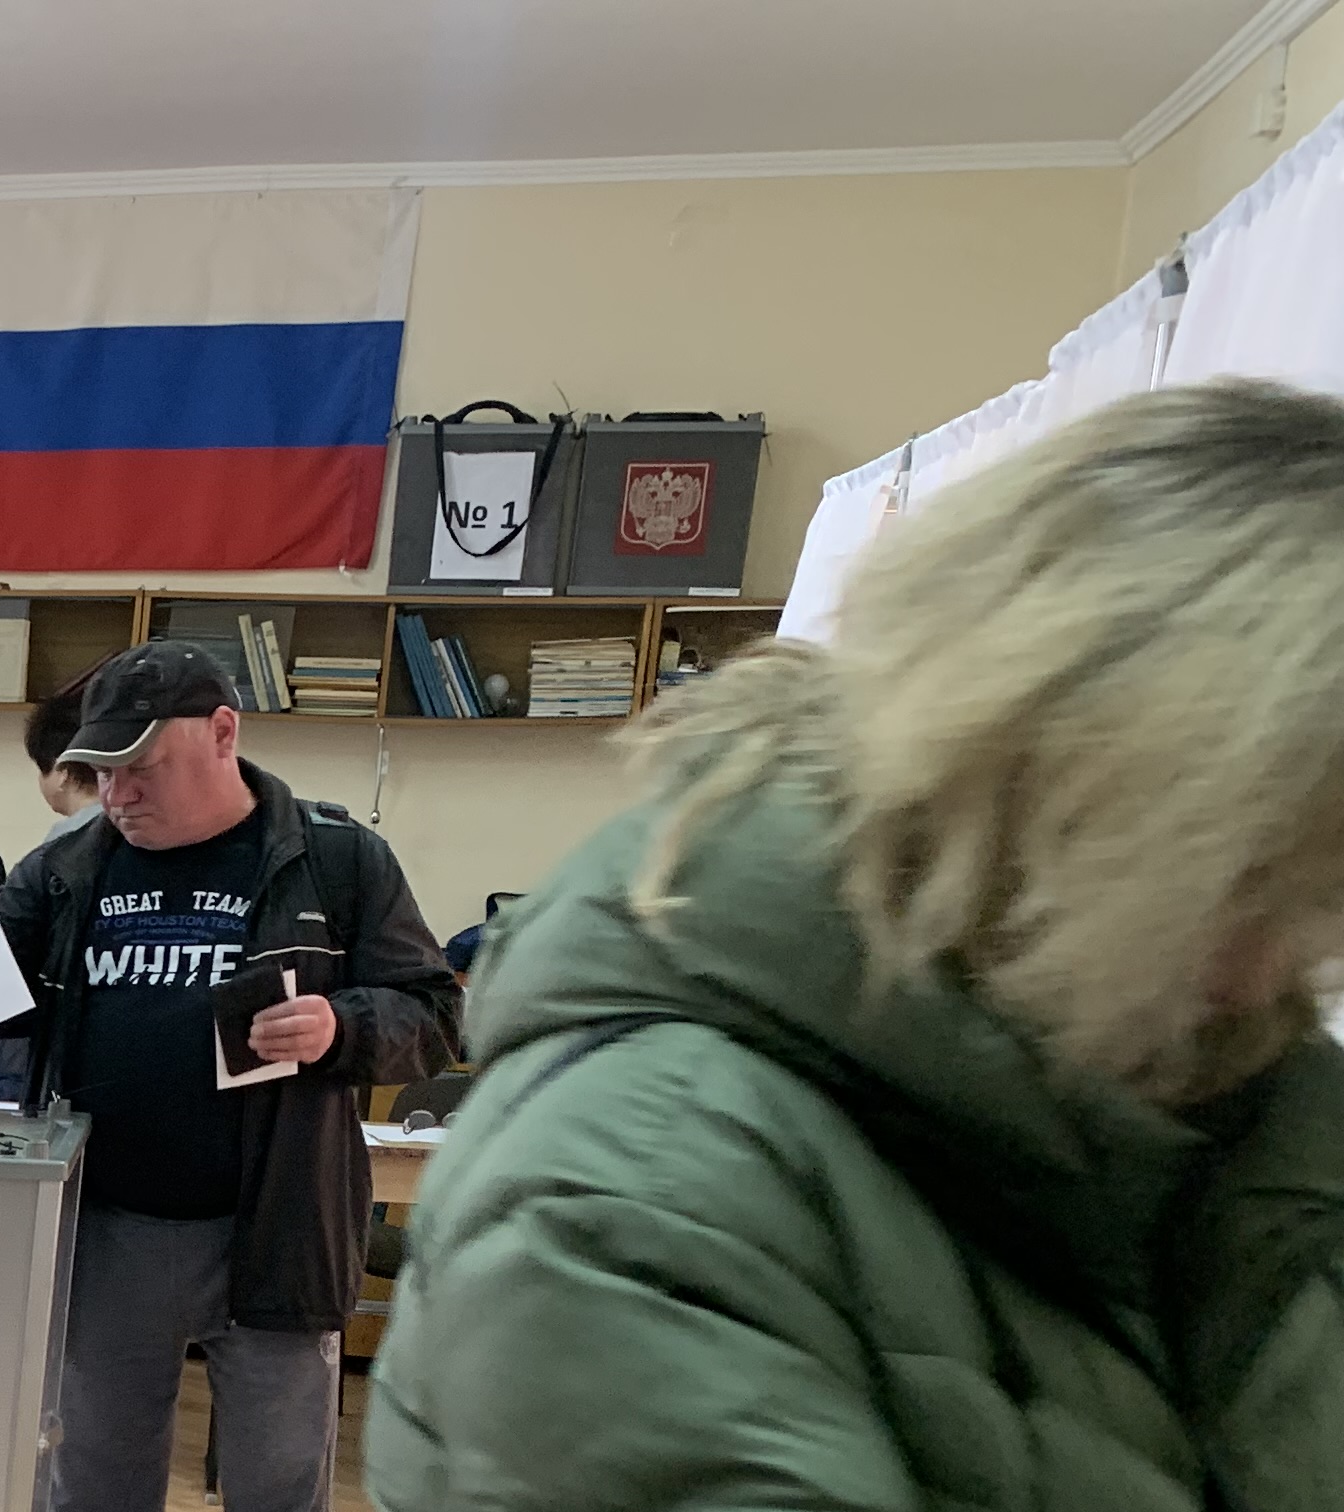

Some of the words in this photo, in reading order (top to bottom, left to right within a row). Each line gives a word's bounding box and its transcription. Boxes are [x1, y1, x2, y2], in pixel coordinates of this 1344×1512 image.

[500, 500, 519, 529] 1
[100, 891, 163, 917] GREAT
[192, 891, 252, 917] TEAM
[113, 916, 135, 929] OF
[137, 914, 206, 927] HOUSTON
[84, 944, 243, 987] WHITE
